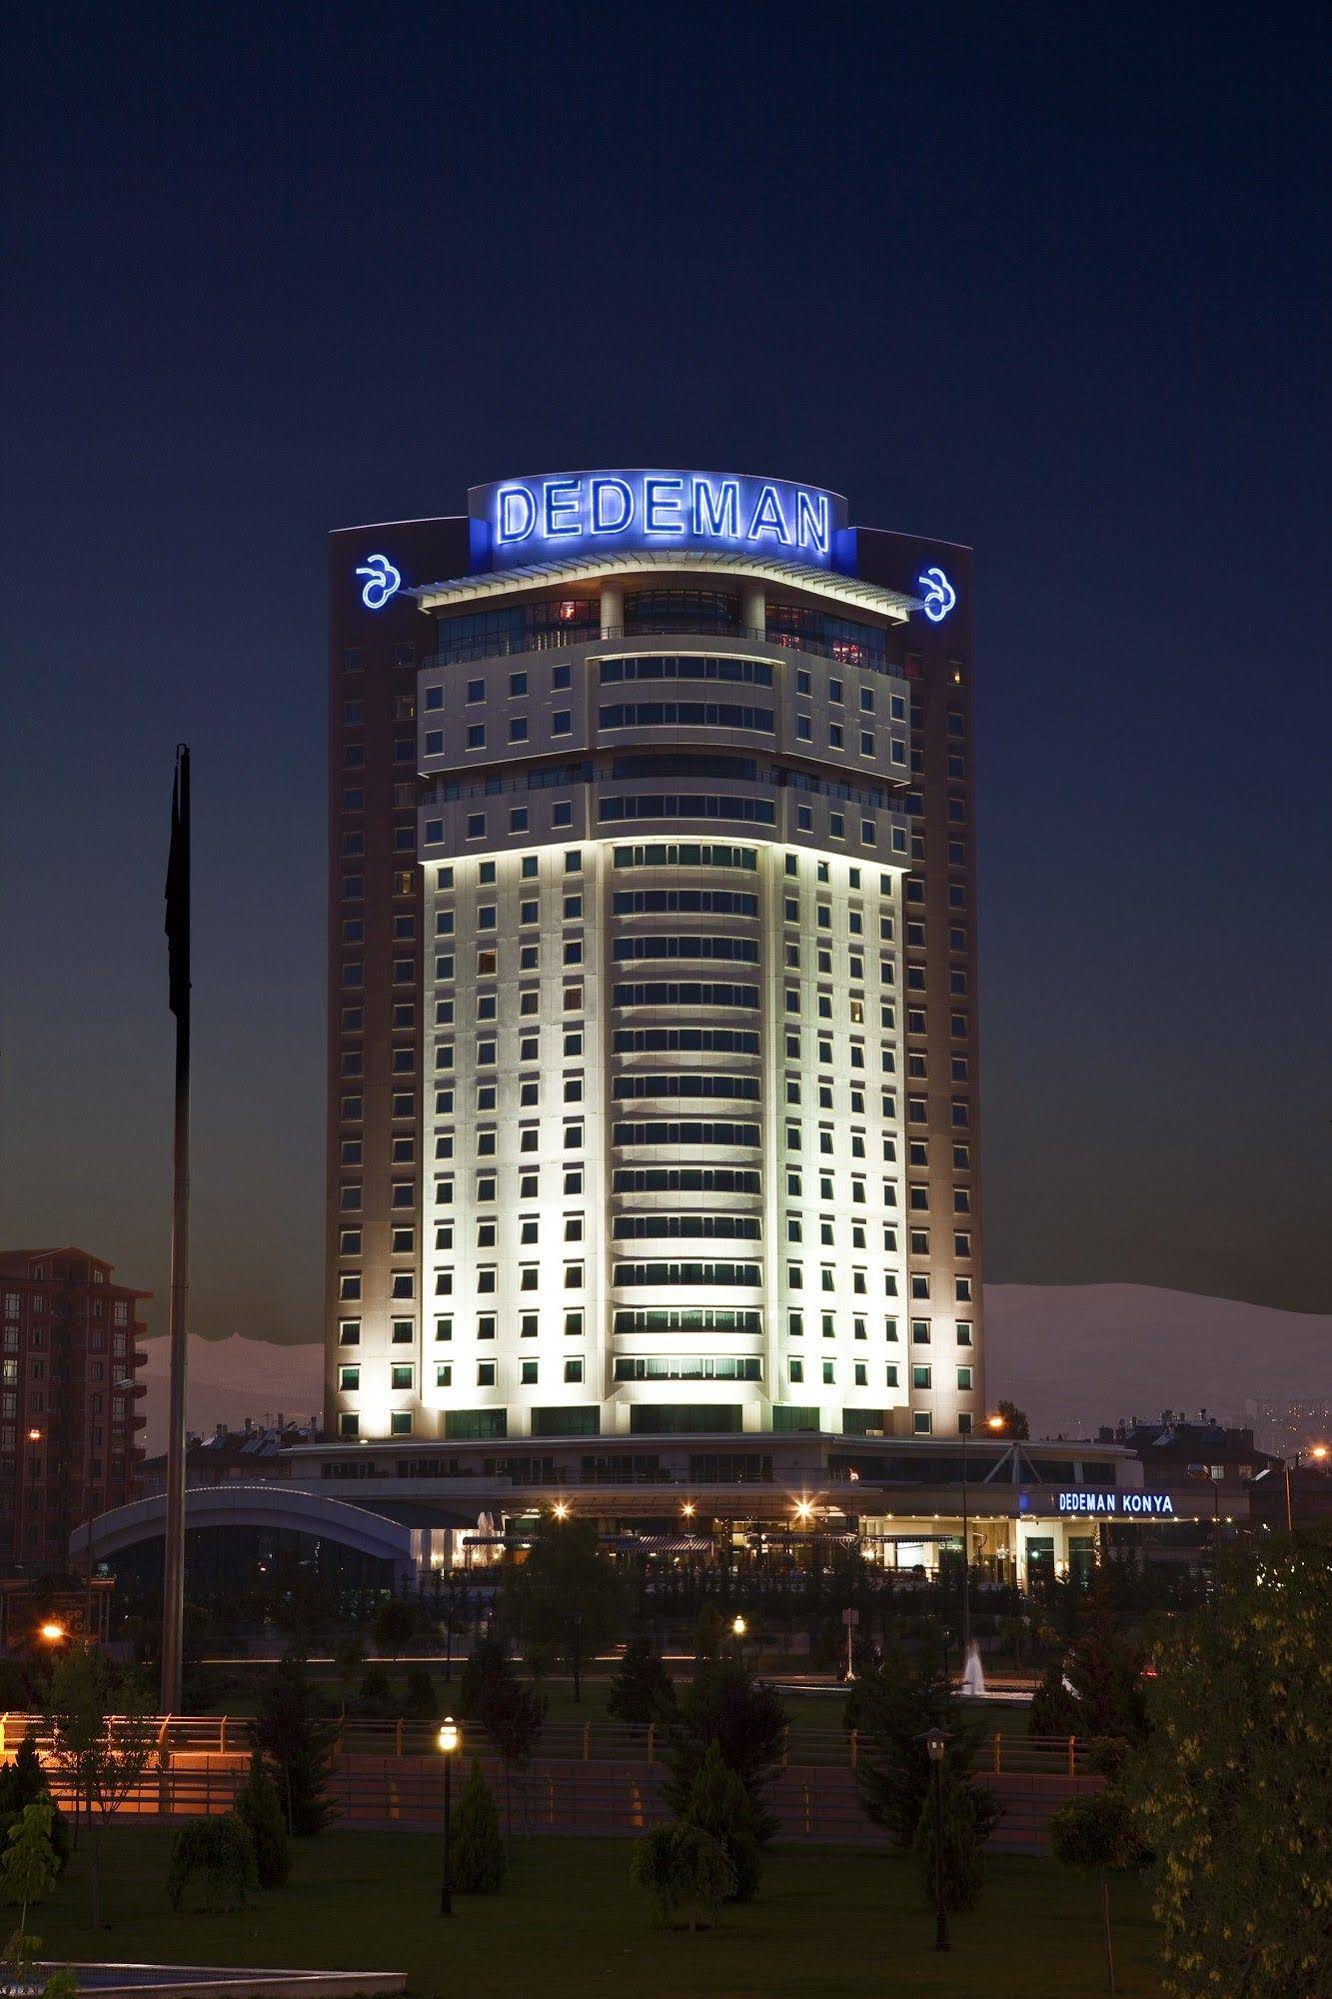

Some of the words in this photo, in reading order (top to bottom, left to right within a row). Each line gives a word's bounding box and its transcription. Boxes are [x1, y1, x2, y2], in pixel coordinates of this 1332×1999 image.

[497, 477, 830, 553] DEDEMAN
[1059, 1493, 1116, 1511] DEDEMAN
[1123, 1495, 1173, 1513] KONYA
